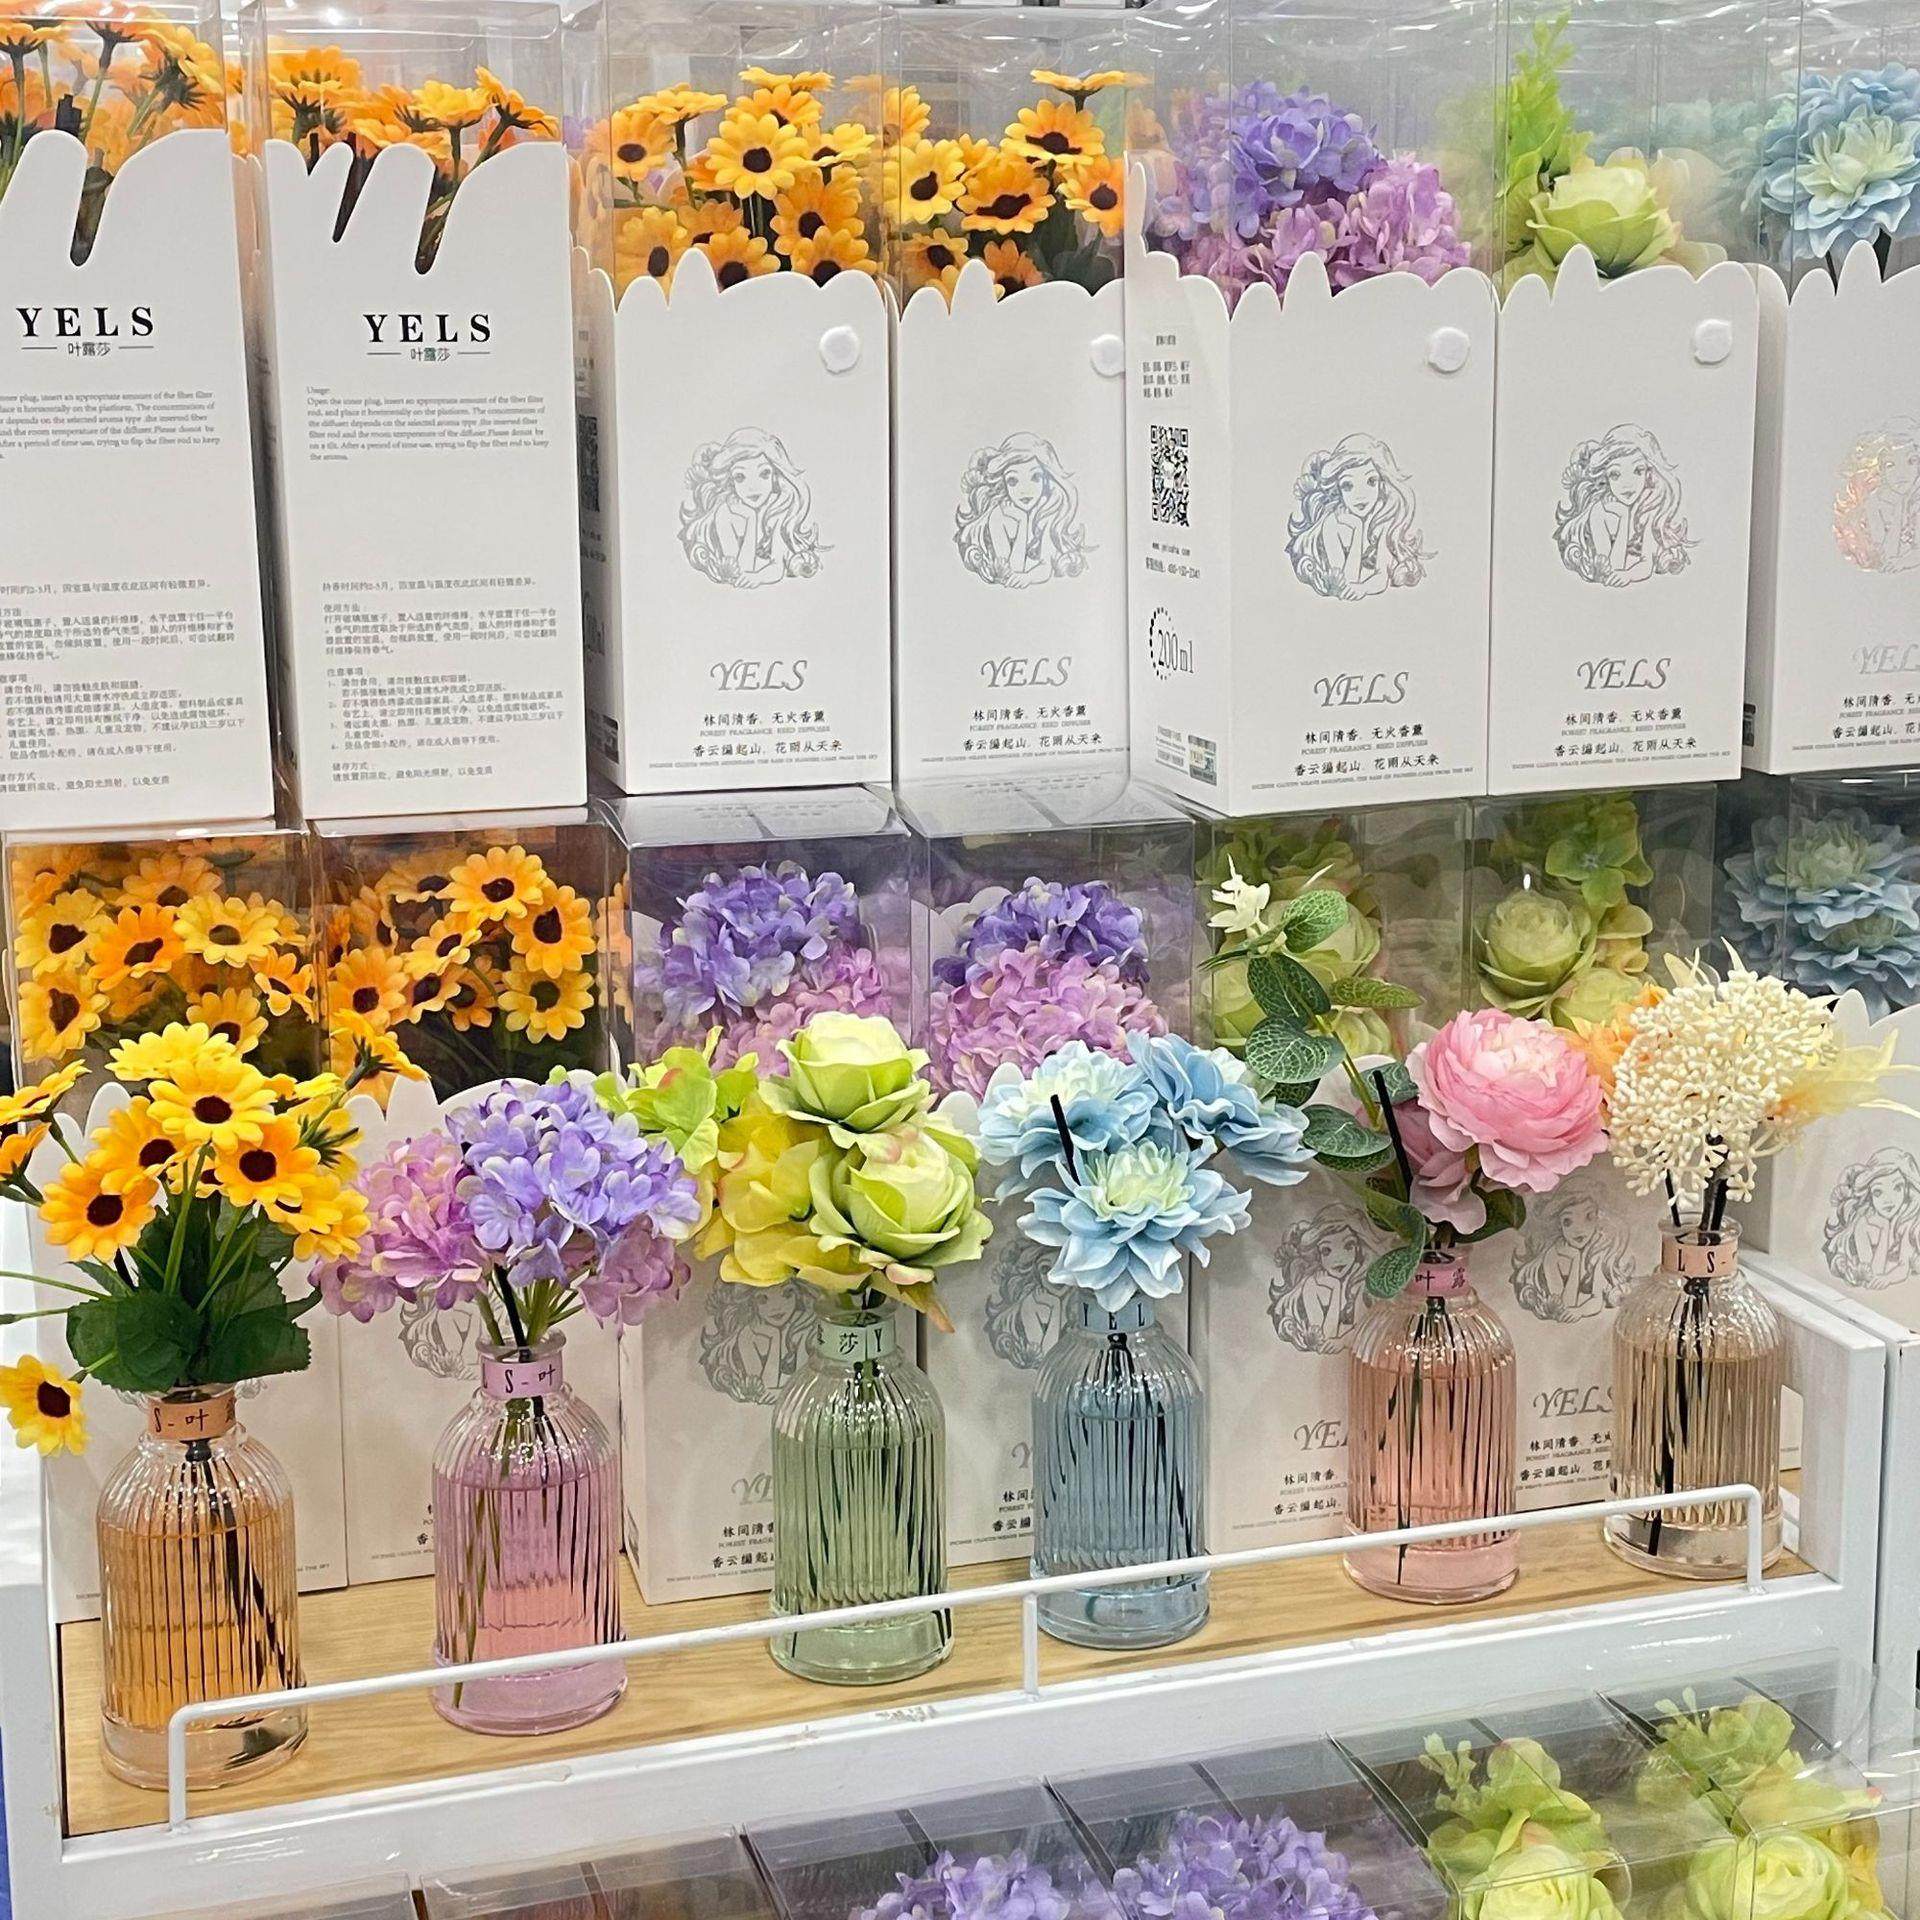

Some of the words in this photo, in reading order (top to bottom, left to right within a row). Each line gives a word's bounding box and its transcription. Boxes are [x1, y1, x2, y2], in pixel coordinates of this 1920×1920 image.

[16, 307, 154, 337] YELS
[363, 314, 491, 343] YELS
[710, 659, 808, 691] YELS
[981, 656, 1072, 688] YELS
[1577, 657, 1671, 690] YELS
[1314, 671, 1410, 707] YELS
[1294, 1419, 1348, 1451] YE
